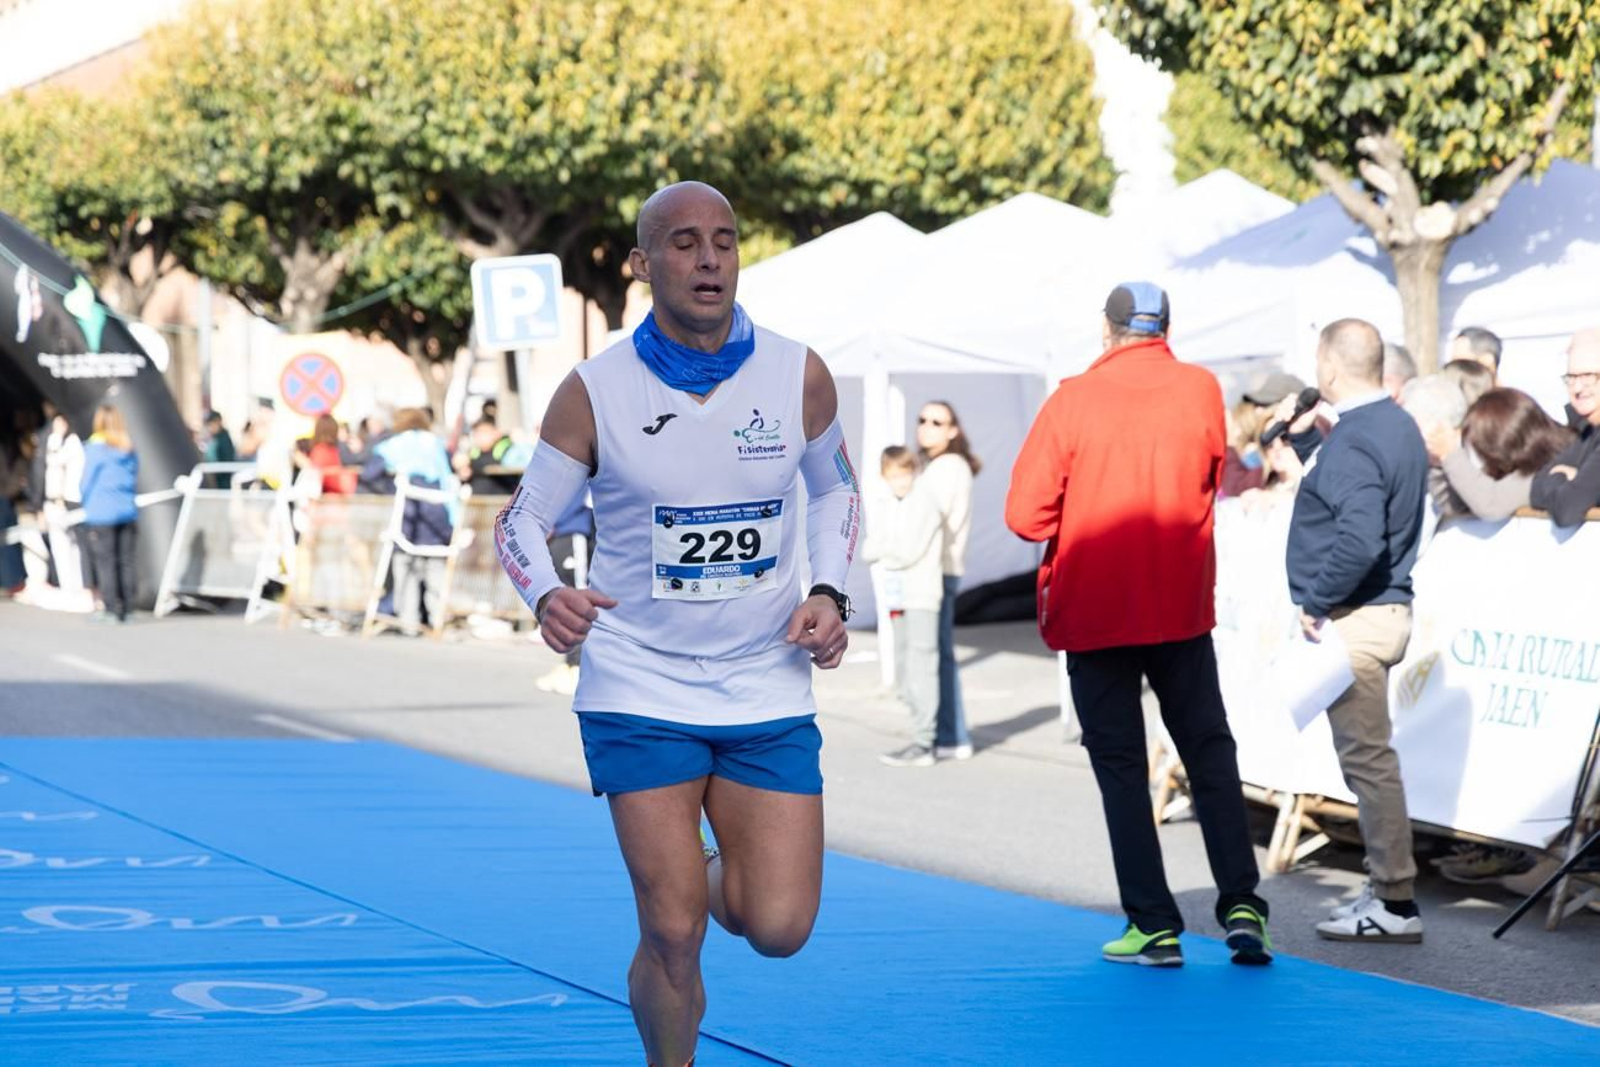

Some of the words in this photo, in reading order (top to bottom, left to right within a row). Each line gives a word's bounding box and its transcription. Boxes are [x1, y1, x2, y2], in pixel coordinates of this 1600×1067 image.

[491, 267, 546, 340] P
[679, 528, 761, 564] 229
[702, 565, 741, 574] EDUARDO
